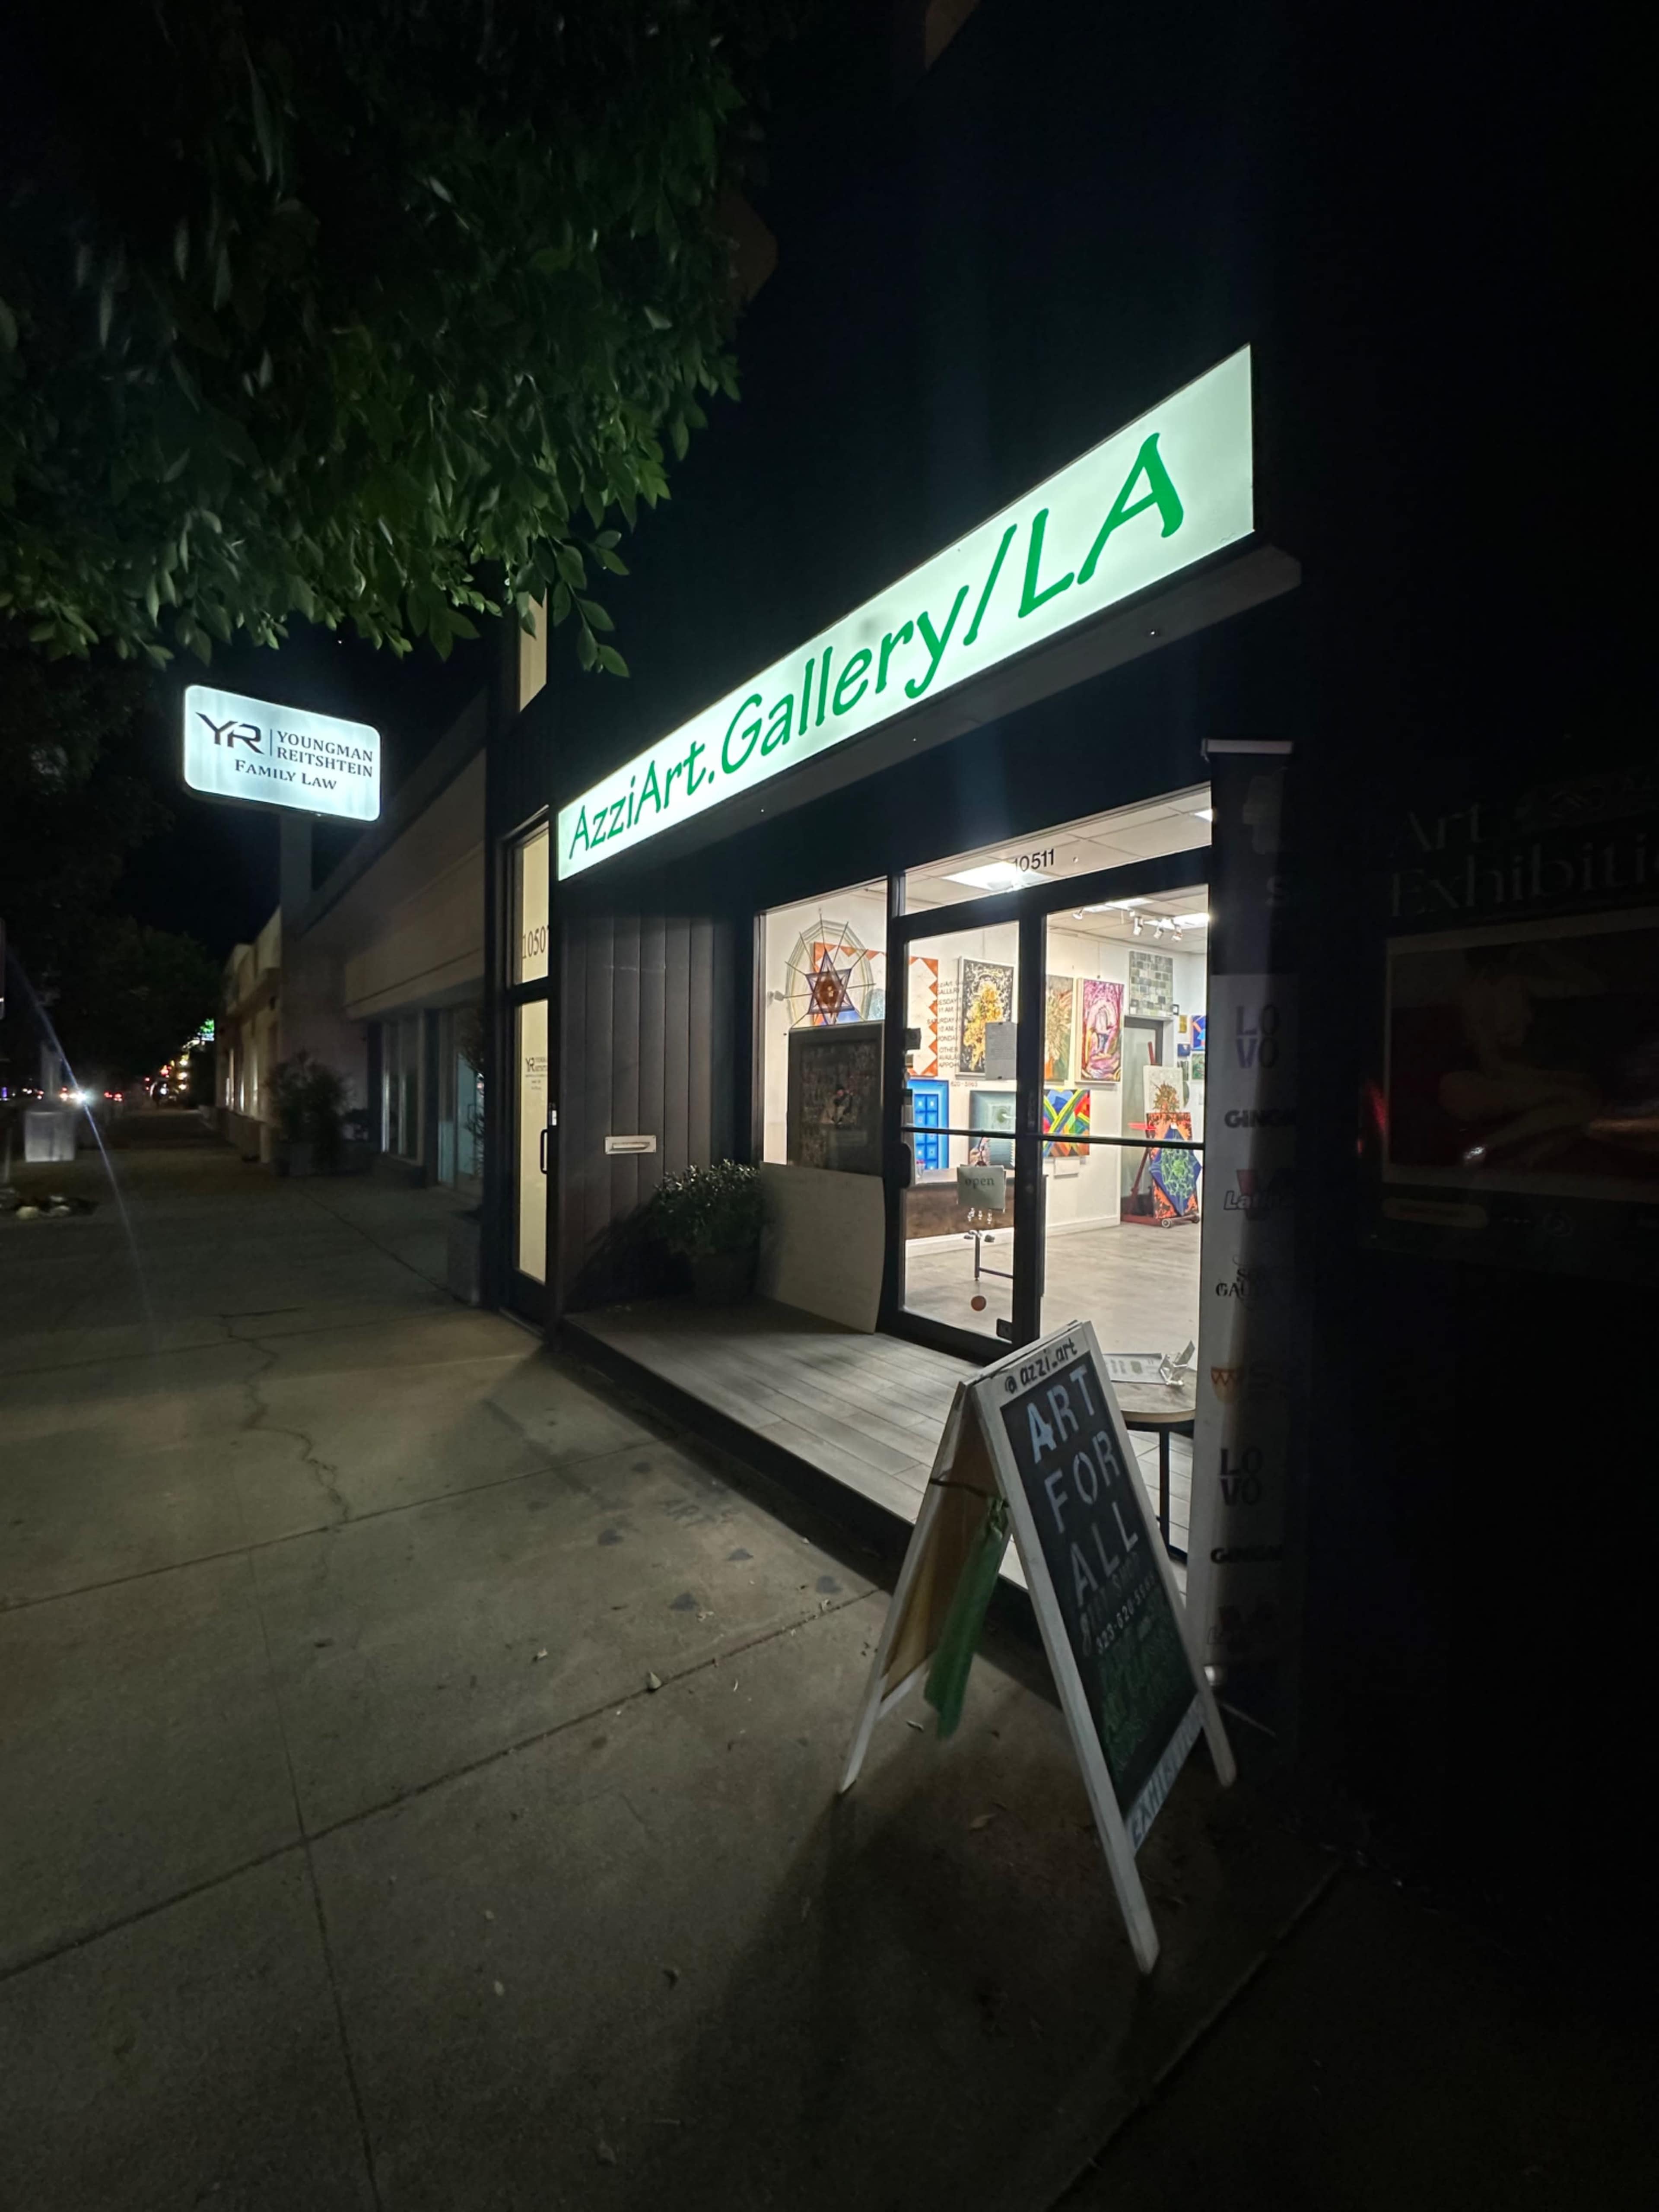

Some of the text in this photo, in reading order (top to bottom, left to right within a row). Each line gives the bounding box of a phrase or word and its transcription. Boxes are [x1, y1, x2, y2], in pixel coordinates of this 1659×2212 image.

[277, 730, 373, 762] YOUNGMAN
[235, 759, 296, 782] FAMILY
[277, 747, 373, 778] REITSHTEIN
[1014, 848, 1055, 872] 10511
[522, 925, 550, 959] 1050
[965, 1178, 995, 1189] open
[1026, 1363, 1095, 1464] ART
[1044, 1430, 1120, 1534] FOR
[1070, 1501, 1138, 1608] ALL
